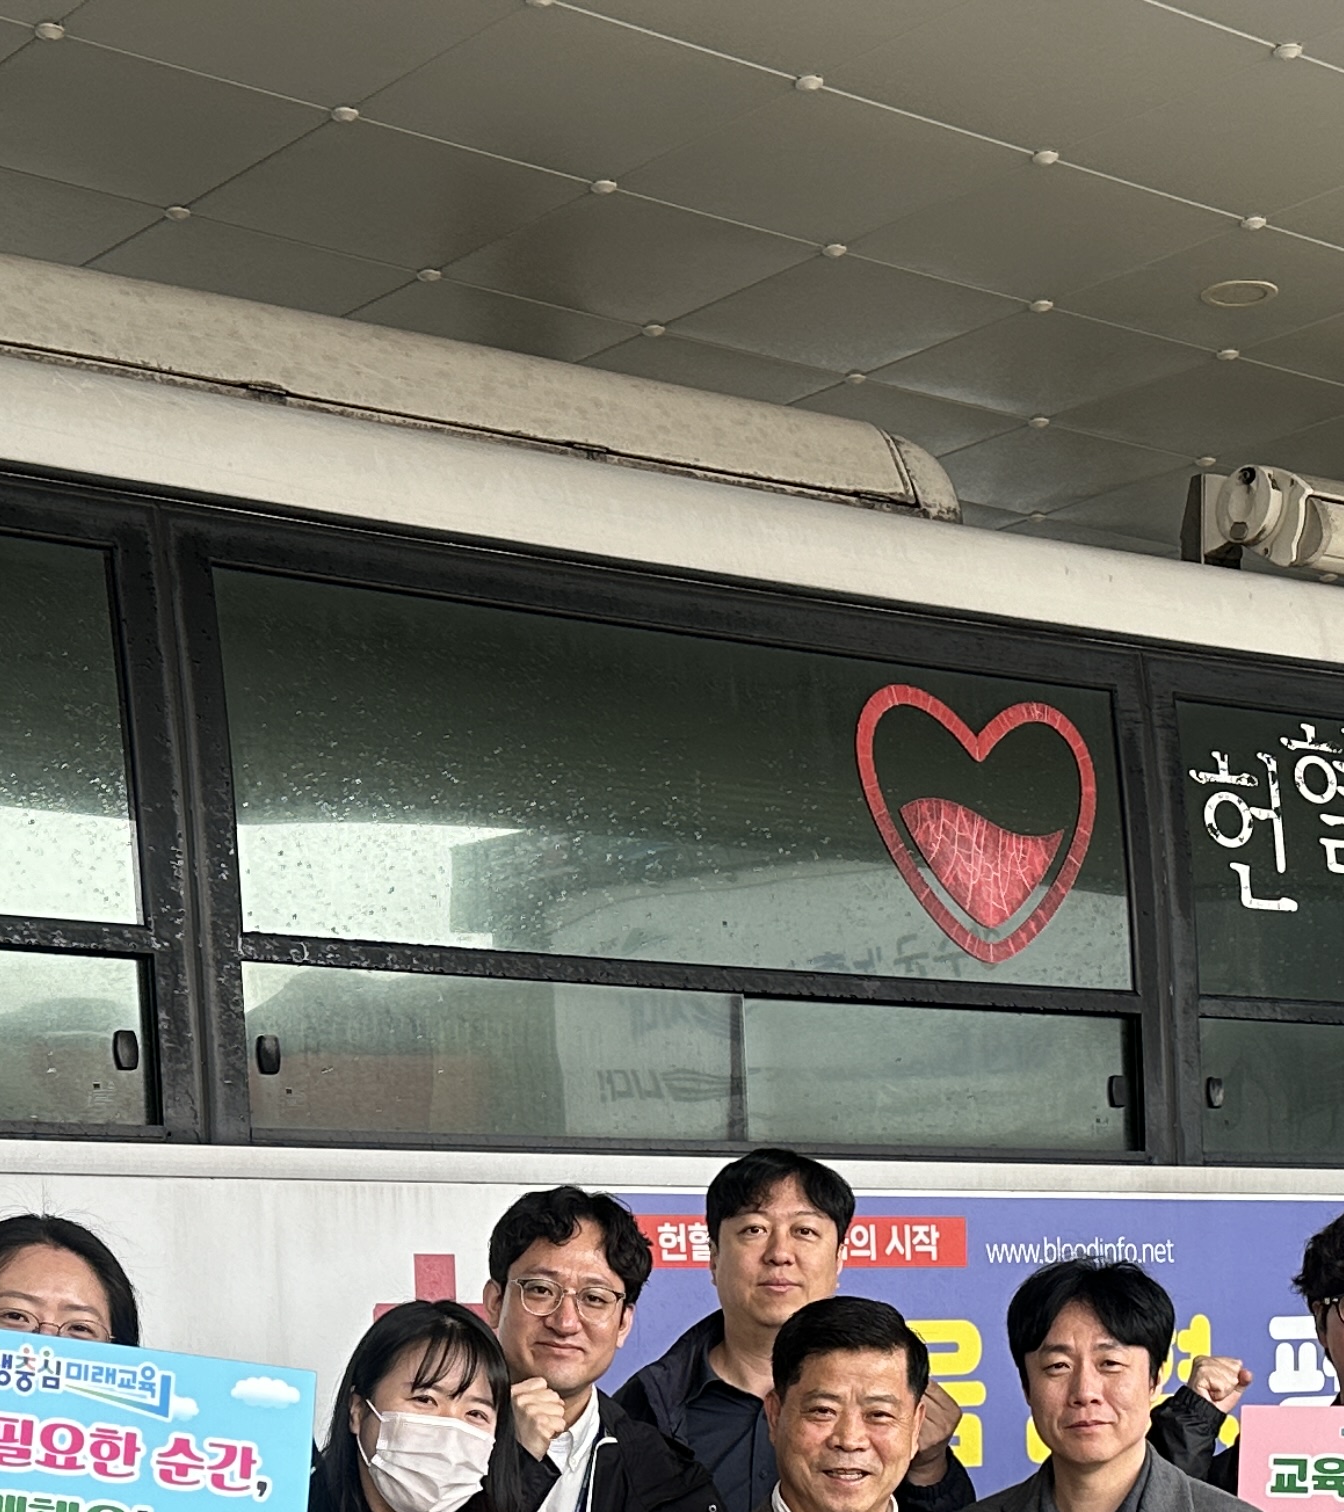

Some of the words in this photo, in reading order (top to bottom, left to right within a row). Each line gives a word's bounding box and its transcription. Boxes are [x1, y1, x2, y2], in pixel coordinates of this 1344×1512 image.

[885, 1224, 940, 1261] 시작
[985, 1236, 1175, 1265] www.bloodinfo.net
[65, 1361, 156, 1399] 미래교육
[156, 1438, 268, 1498] 순간,
